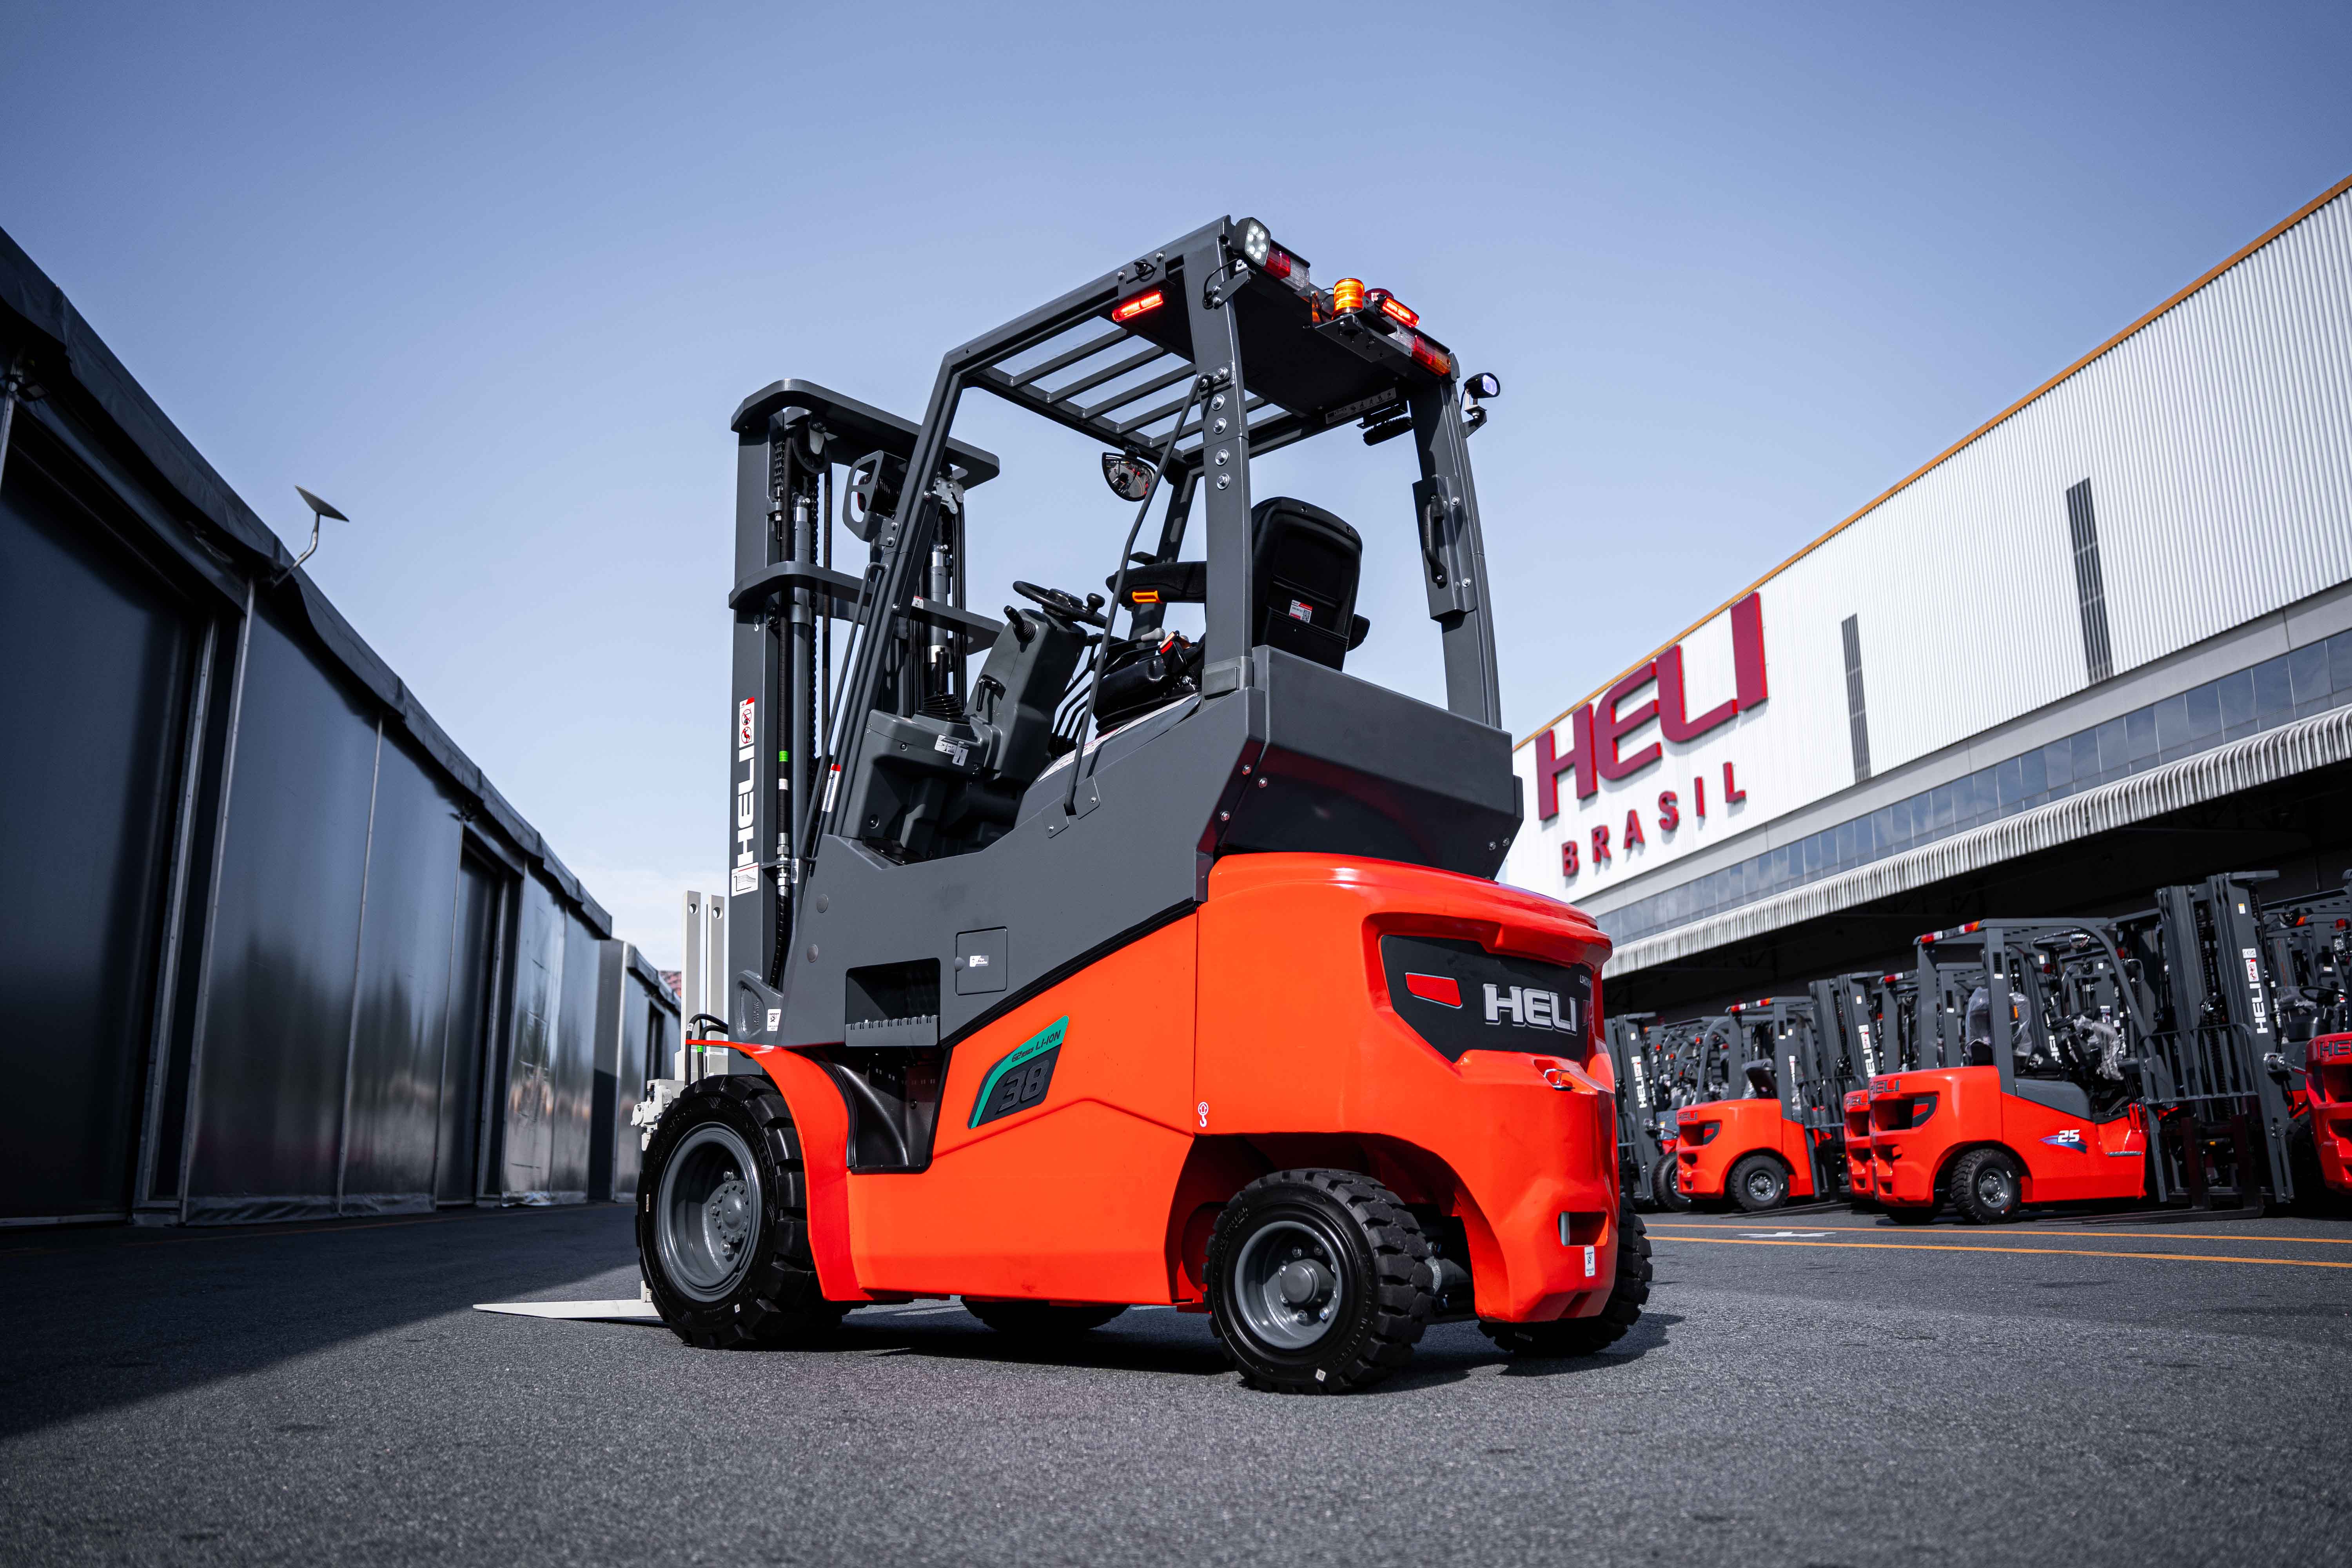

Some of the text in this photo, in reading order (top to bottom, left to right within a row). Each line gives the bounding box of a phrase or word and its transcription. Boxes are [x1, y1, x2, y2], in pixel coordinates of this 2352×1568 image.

[1535, 592, 1768, 821] HELI
[737, 745, 755, 866] HELI
[1562, 761, 1747, 877] BRASIL
[1483, 984, 1577, 1035] HELI
[2249, 983, 2268, 1034] HELI
[1035, 1029, 1061, 1051] LI-ION
[2320, 1040, 2352, 1056] HE
[998, 1060, 1050, 1109] 38
[1635, 1077, 1648, 1108] HELI
[2057, 1129, 2080, 1143] 25
